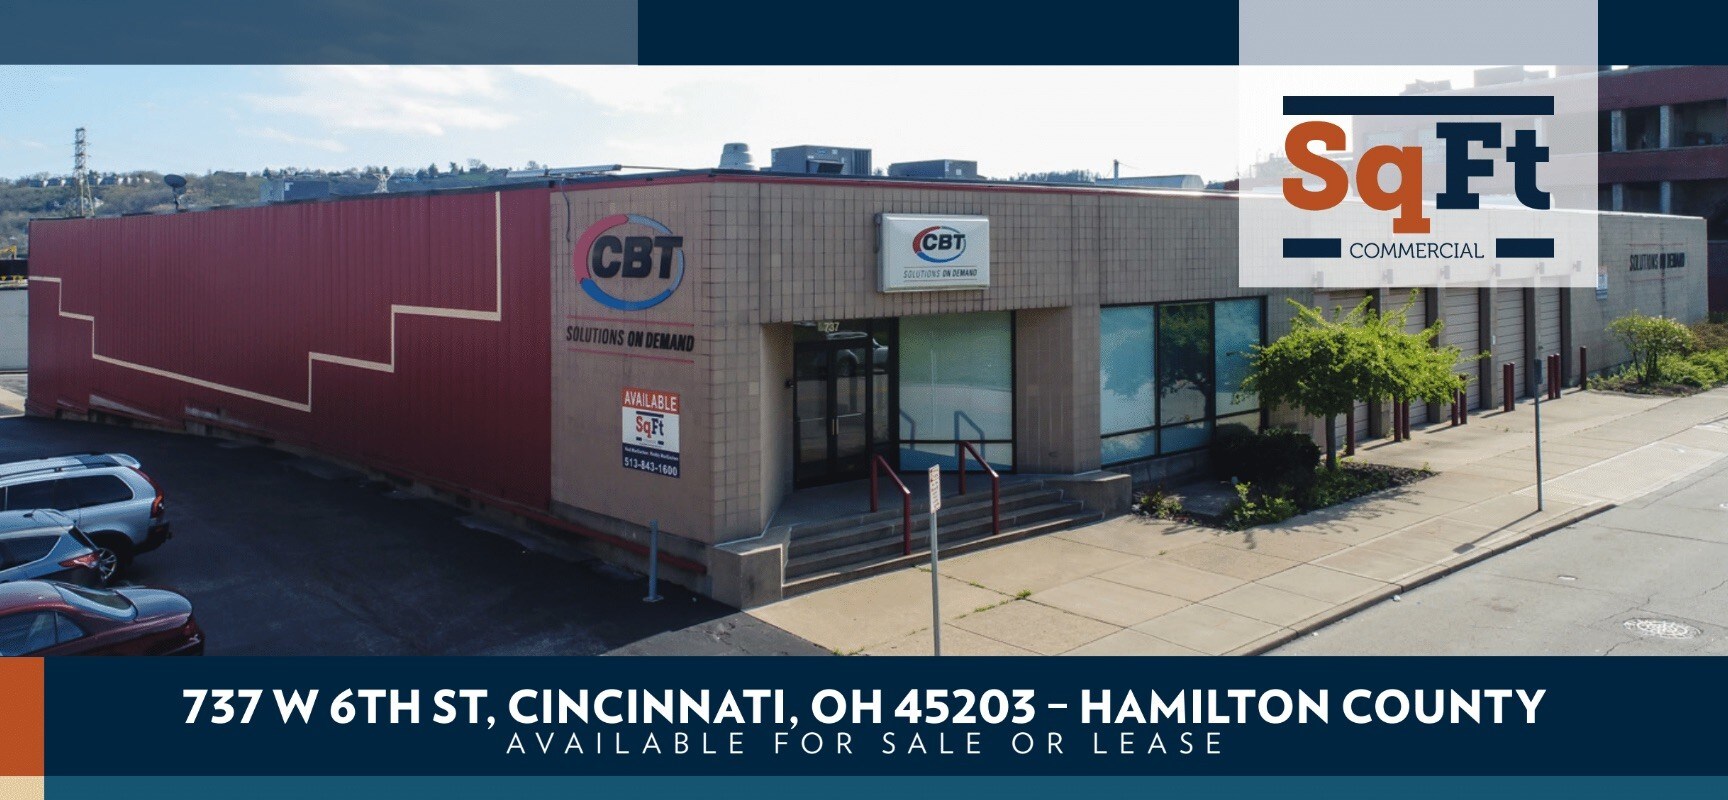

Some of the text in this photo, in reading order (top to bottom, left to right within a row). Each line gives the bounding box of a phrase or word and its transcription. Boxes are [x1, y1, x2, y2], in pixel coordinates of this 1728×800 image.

[922, 233, 966, 250] CBT
[592, 235, 683, 279] CBT
[903, 269, 940, 278] SOLUTIONS
[952, 269, 977, 277] DEMAND
[824, 322, 840, 332] 737
[566, 326, 694, 352] SOLUTIONS ON DEMAND
[624, 391, 677, 411] AVAILABLE
[636, 415, 664, 438] SqFt
[624, 457, 678, 476] 513-843-1600
